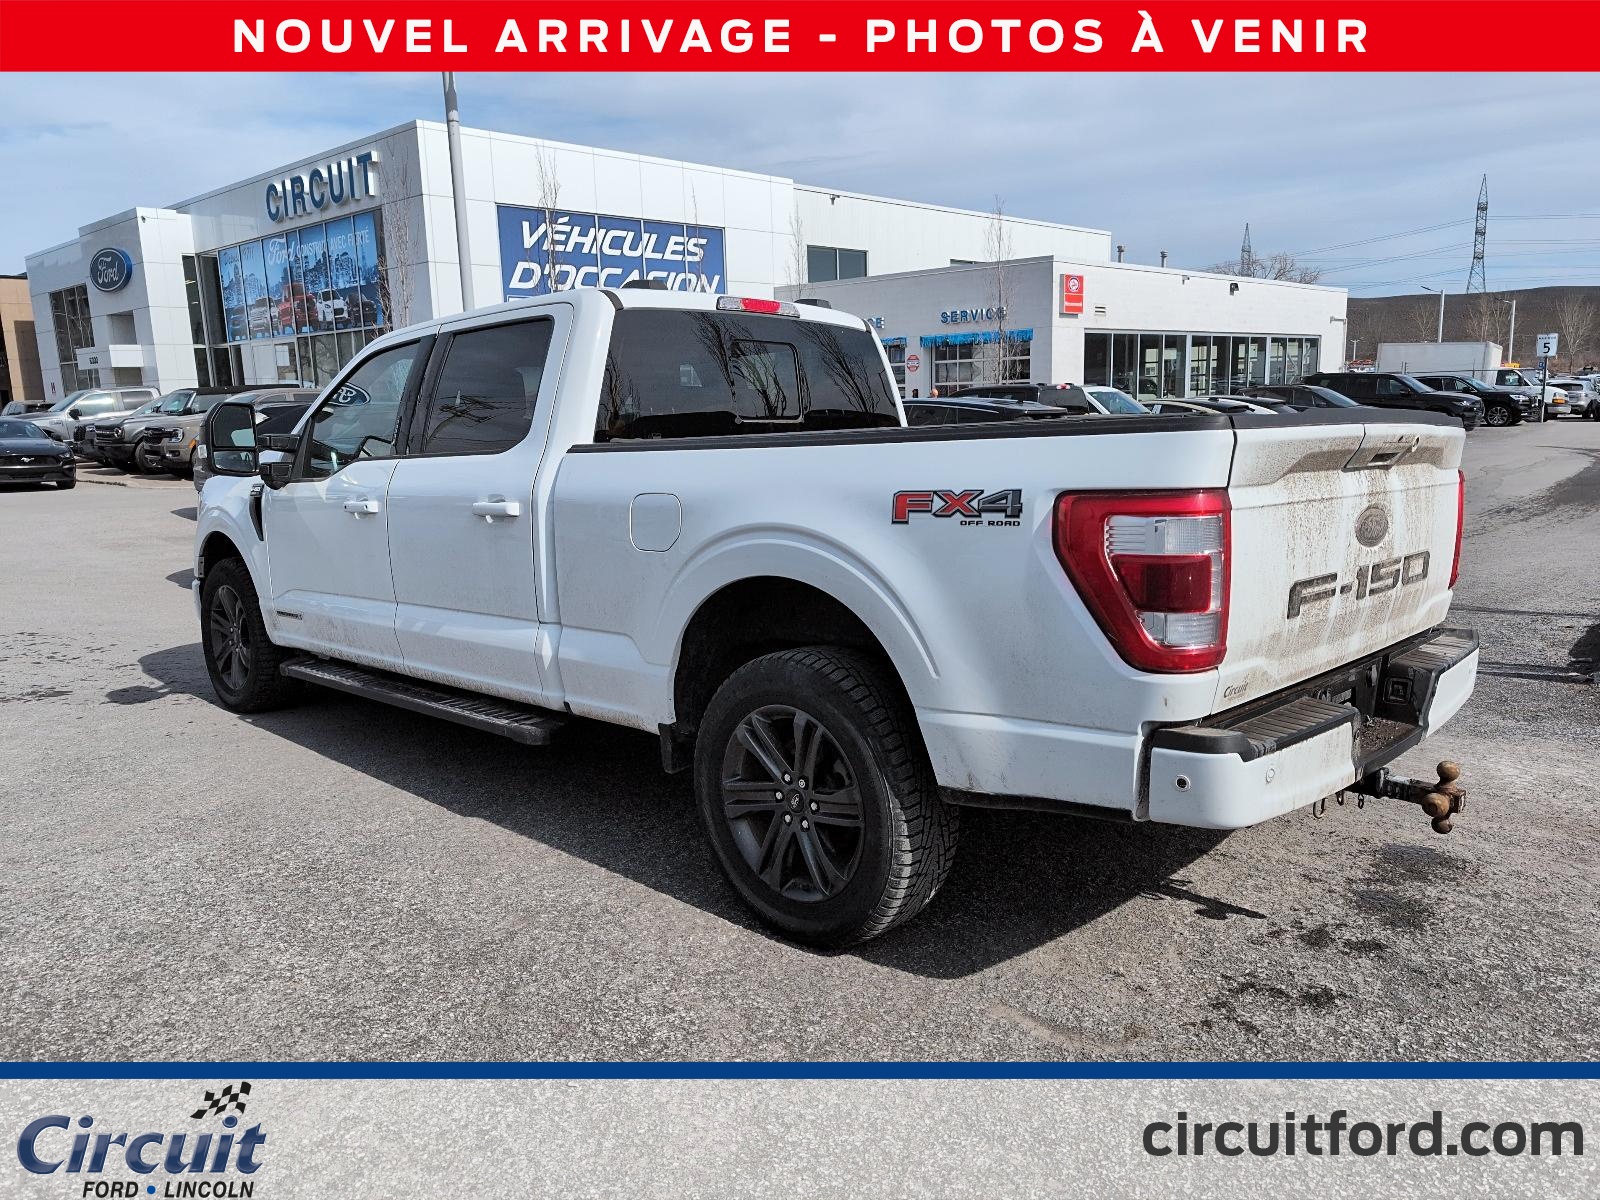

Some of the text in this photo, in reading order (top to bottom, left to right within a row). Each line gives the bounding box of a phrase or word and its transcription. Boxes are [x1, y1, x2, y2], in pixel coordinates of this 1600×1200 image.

[266, 151, 374, 221] CIRCUIT
[522, 216, 707, 262] VÉHICULES
[97, 256, 119, 284] Ford
[941, 306, 1005, 324] SERVICE
[1543, 342, 1551, 354] 5
[891, 489, 1022, 525] FX4
[1287, 550, 1431, 619] F-150
[1223, 681, 1249, 698] Circuit
